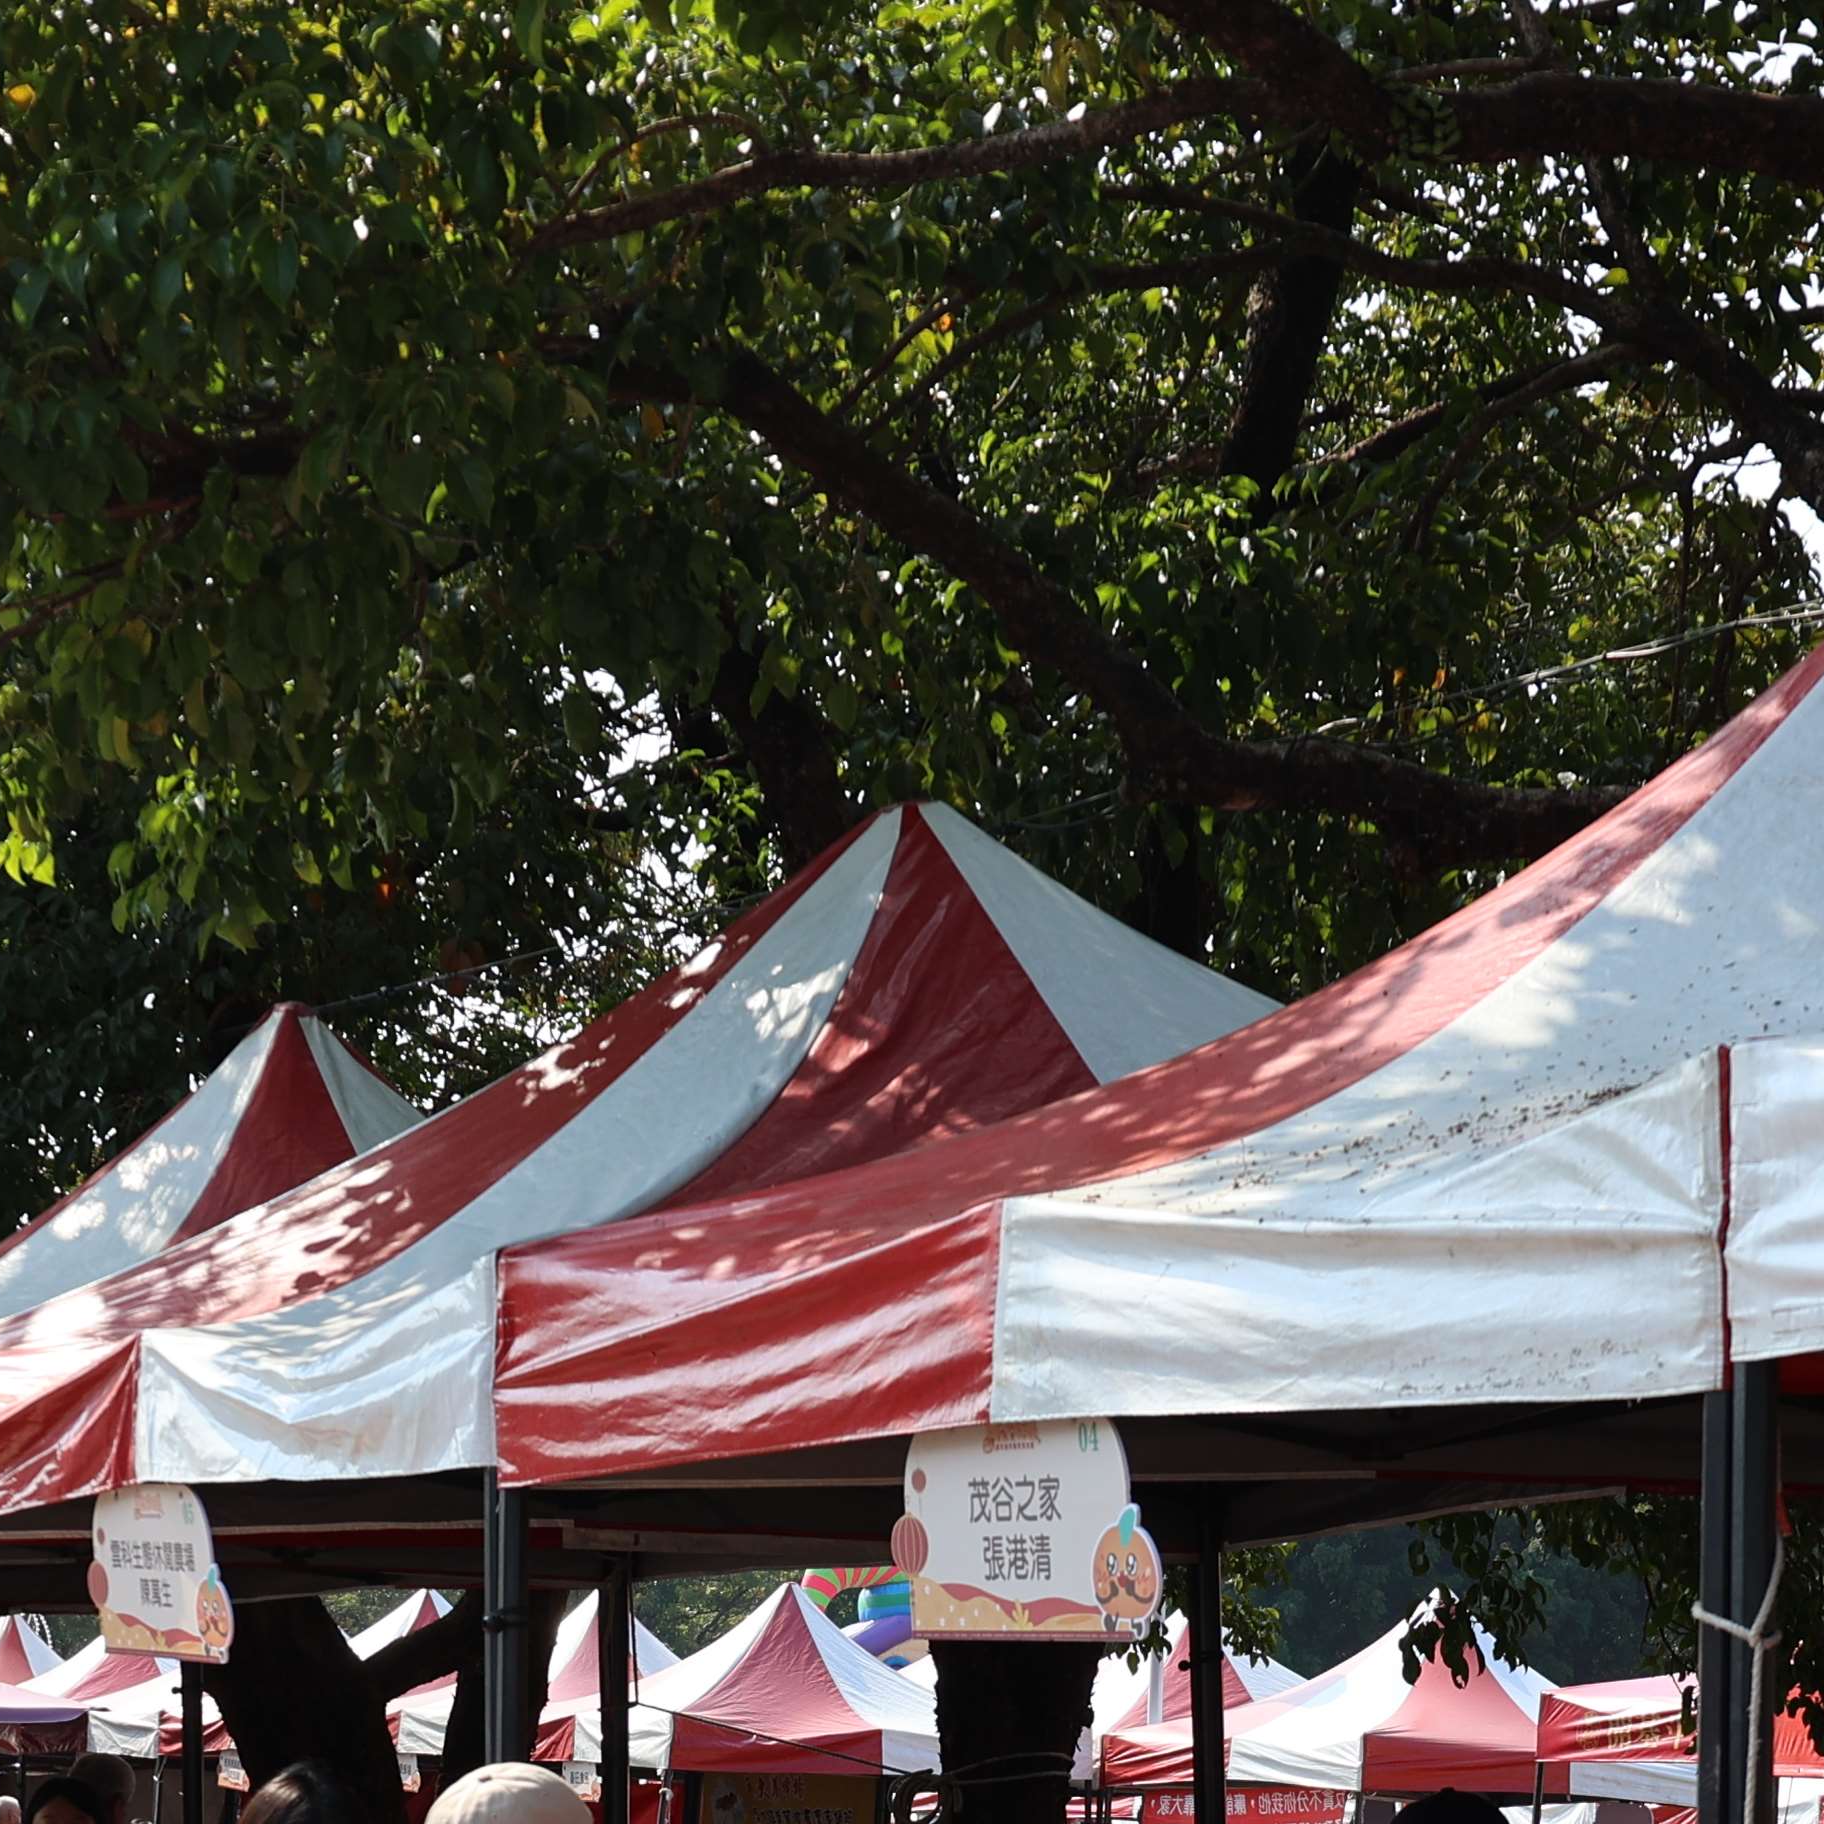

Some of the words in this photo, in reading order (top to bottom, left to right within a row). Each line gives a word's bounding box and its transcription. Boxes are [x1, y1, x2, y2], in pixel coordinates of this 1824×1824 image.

[1079, 1422, 1099, 1451] 04
[968, 1475, 1062, 1524] 茂谷之家
[983, 1534, 1052, 1582] 張港清
